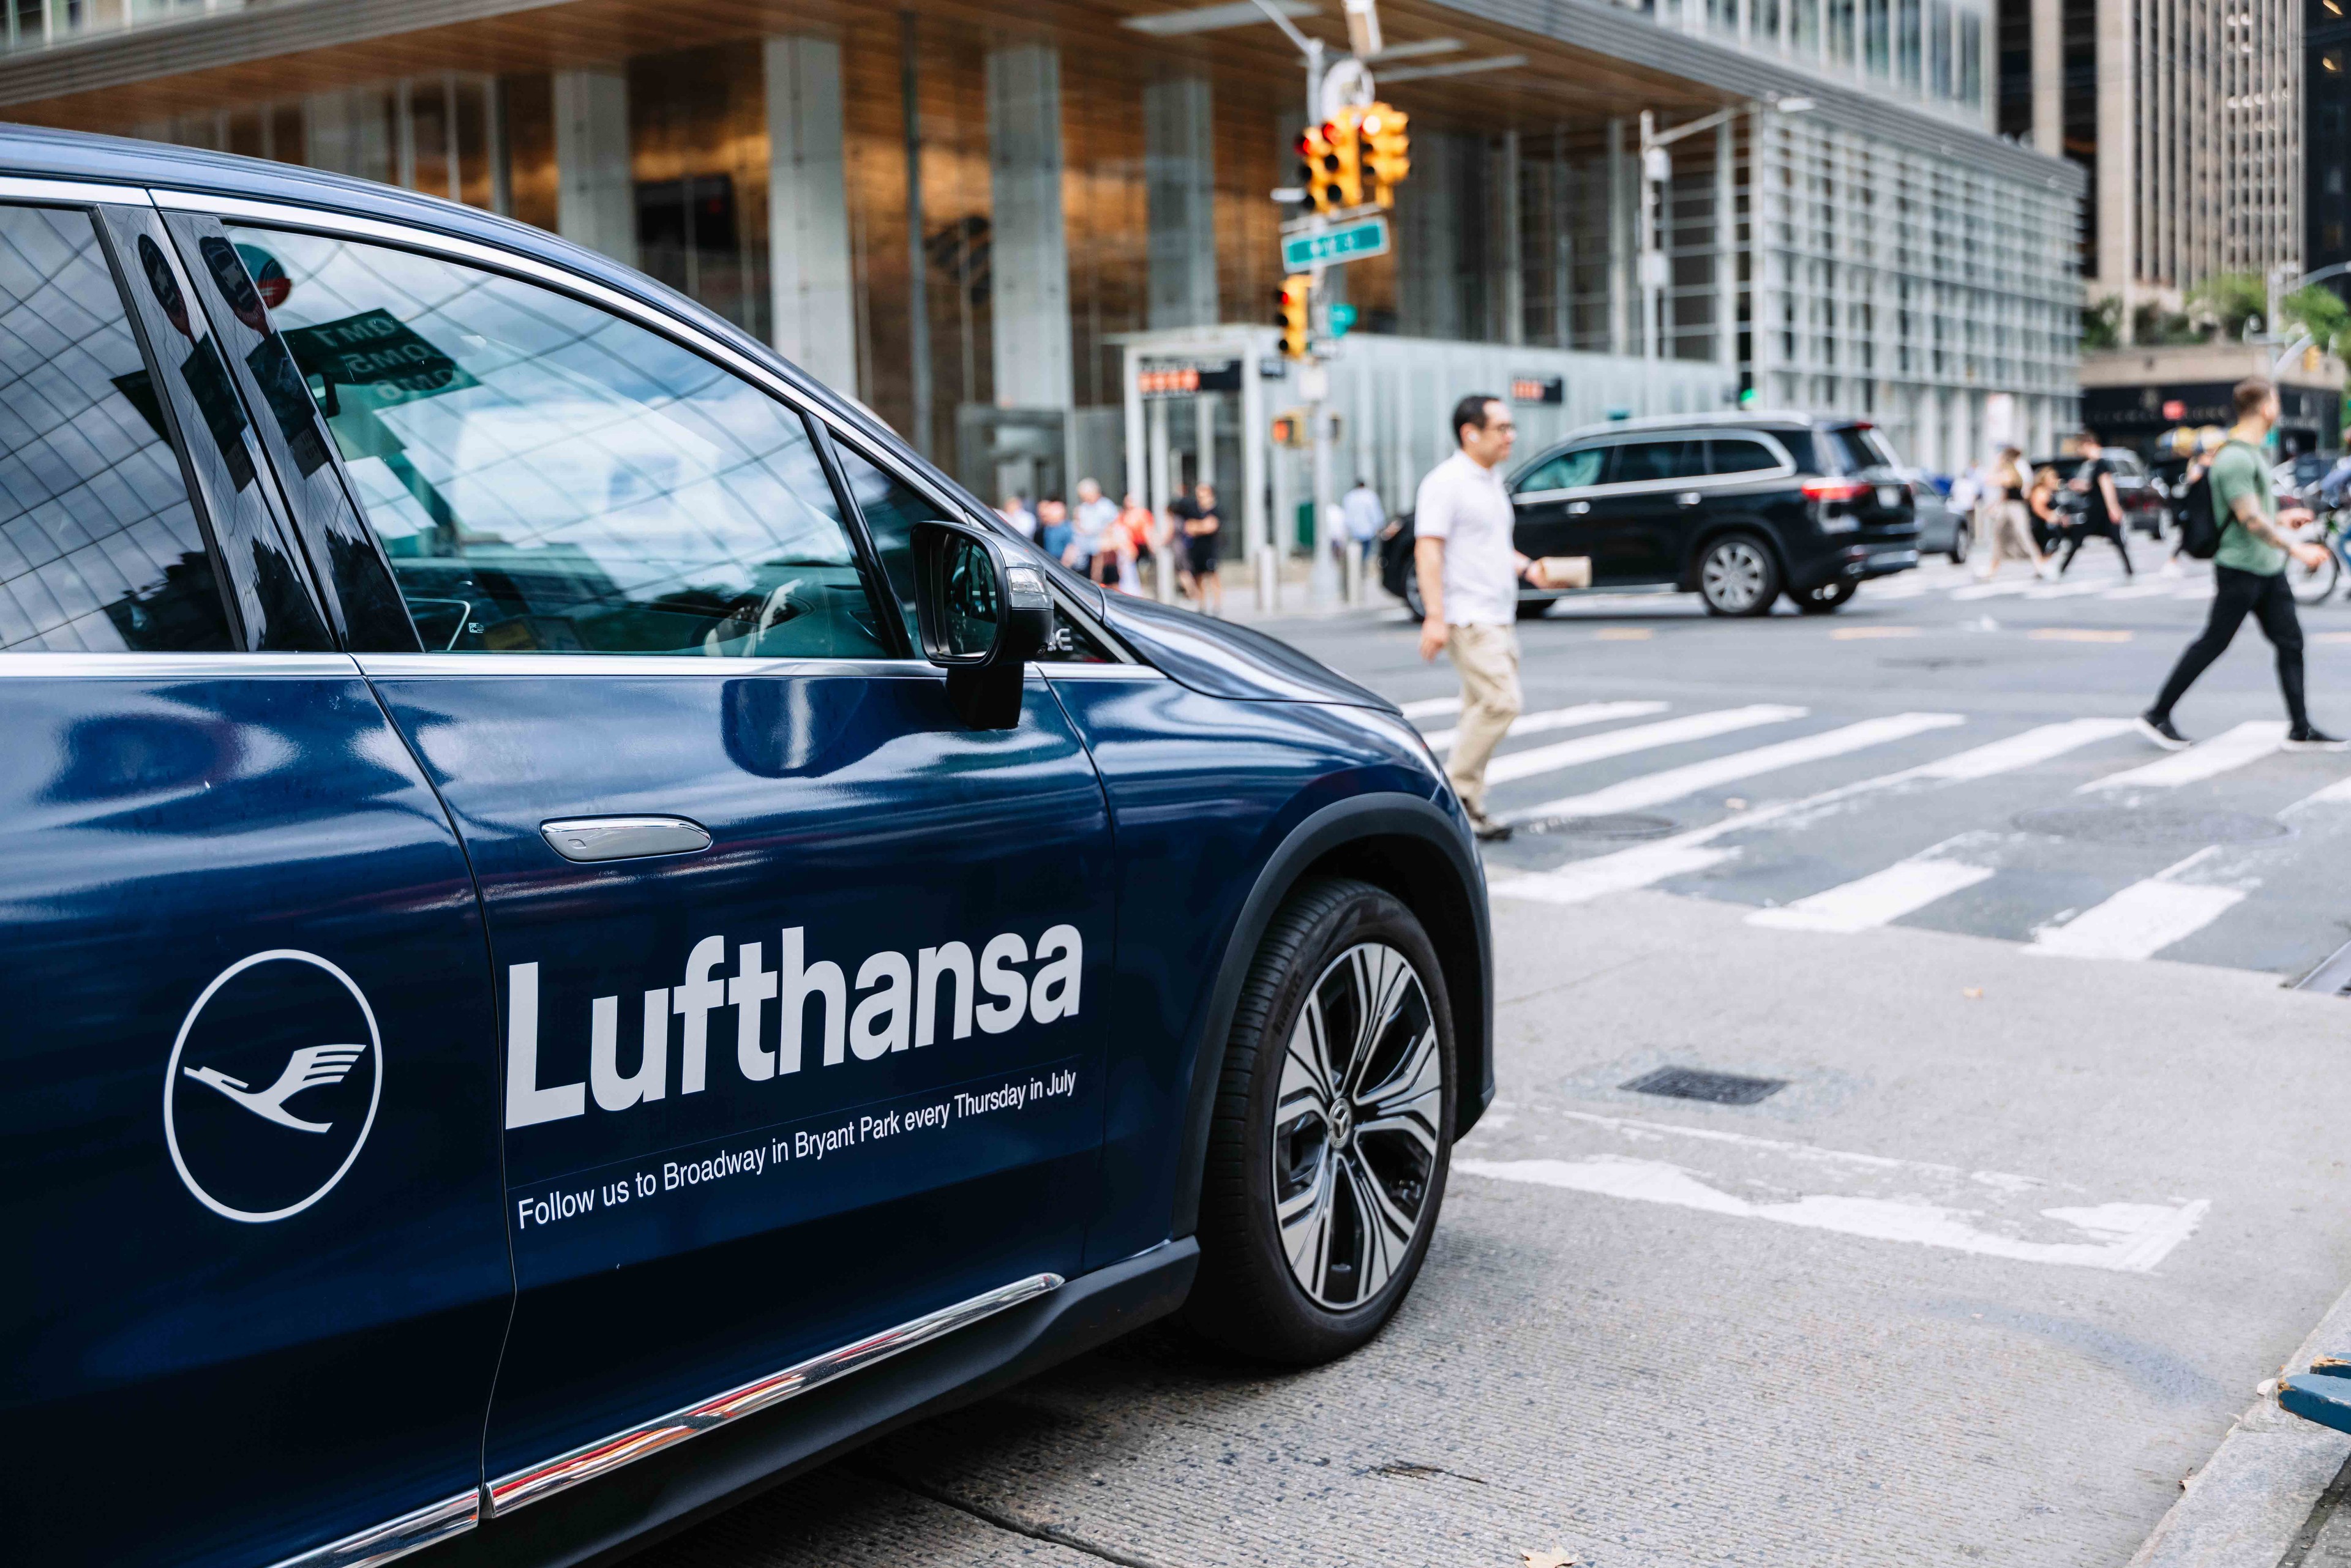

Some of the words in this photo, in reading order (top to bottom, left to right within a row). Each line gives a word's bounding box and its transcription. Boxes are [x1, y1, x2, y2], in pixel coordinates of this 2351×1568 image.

[506, 923, 1083, 1130] Lufthansa
[518, 1189, 594, 1229] Follow
[602, 1180, 629, 1207] us
[635, 1172, 656, 1198] to
[664, 1147, 766, 1190] Broadway
[772, 1138, 789, 1164] in
[795, 1121, 855, 1160] Bryant
[860, 1111, 901, 1142] Park
[904, 1102, 951, 1129] every
[954, 1083, 1027, 1118] Thursday
[1030, 1078, 1043, 1100] in
[1046, 1069, 1077, 1097] July
